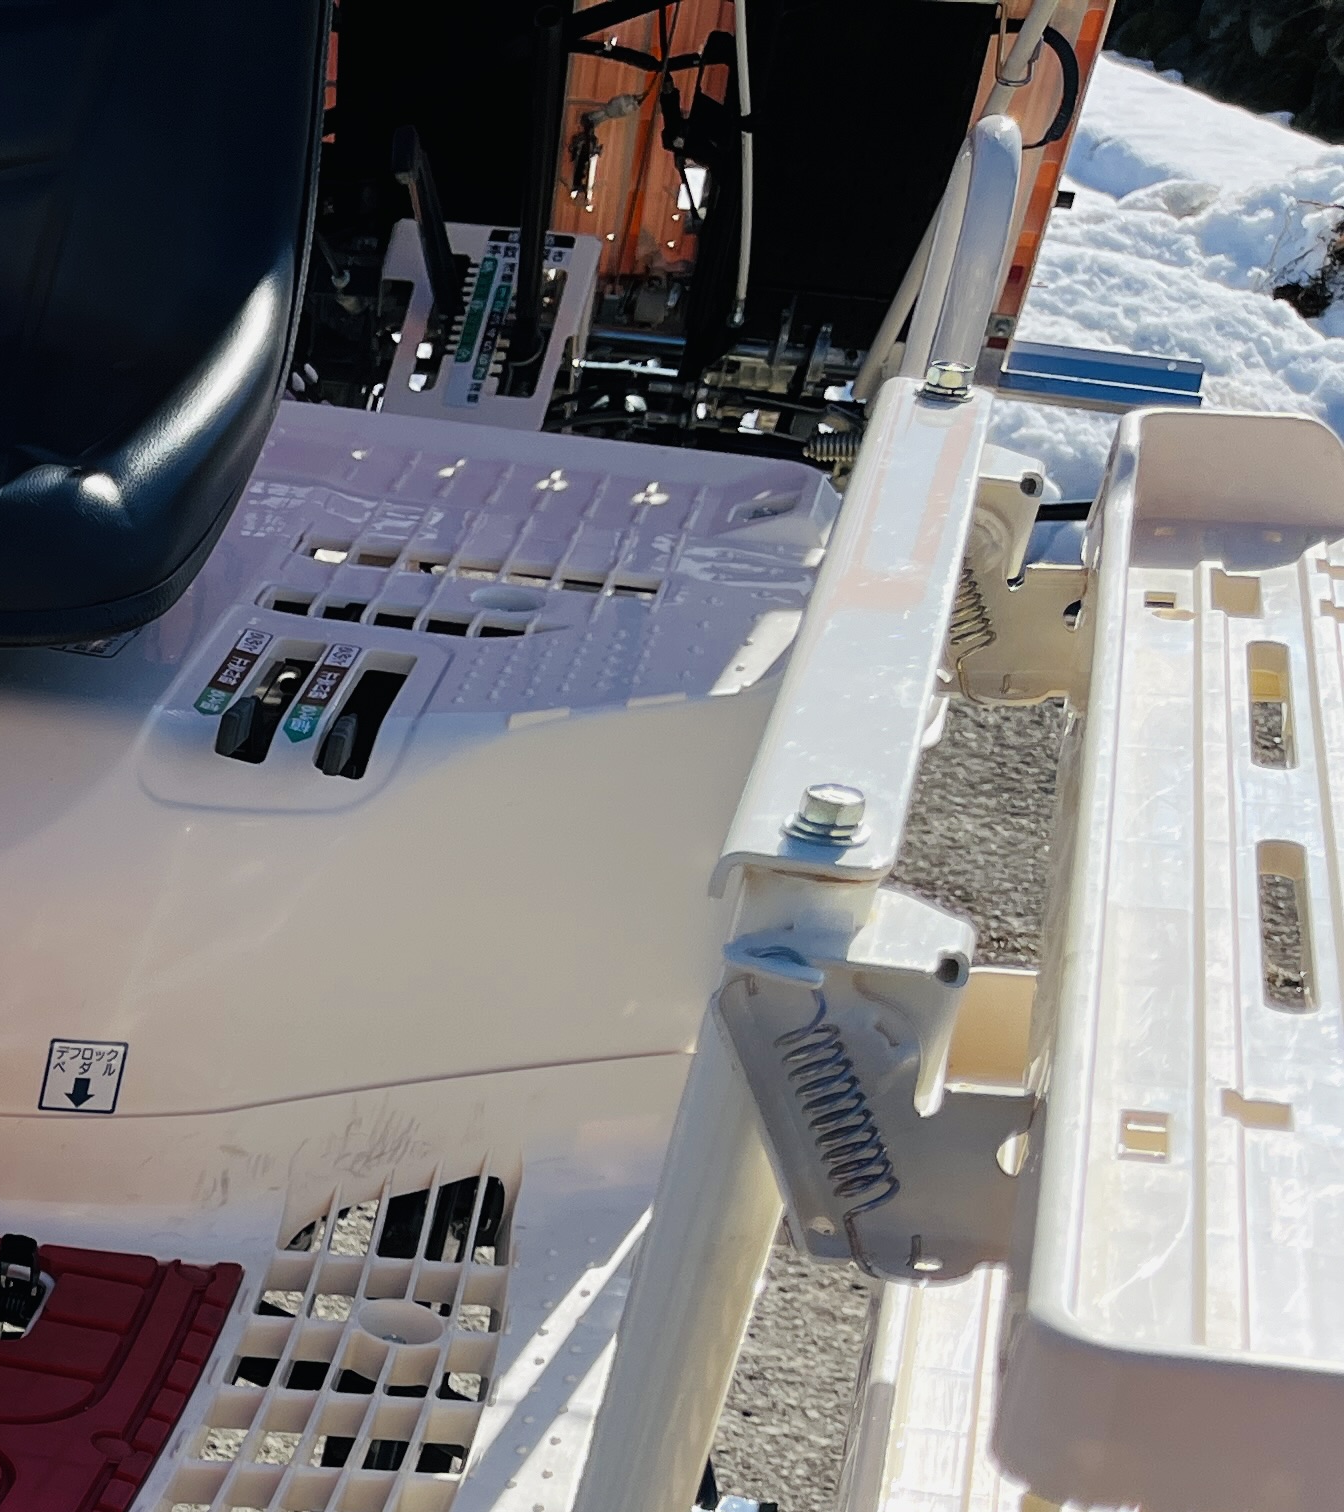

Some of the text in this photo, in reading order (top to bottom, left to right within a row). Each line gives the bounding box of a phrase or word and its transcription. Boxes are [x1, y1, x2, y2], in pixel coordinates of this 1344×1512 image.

[56, 1045, 119, 1062] デフロック
